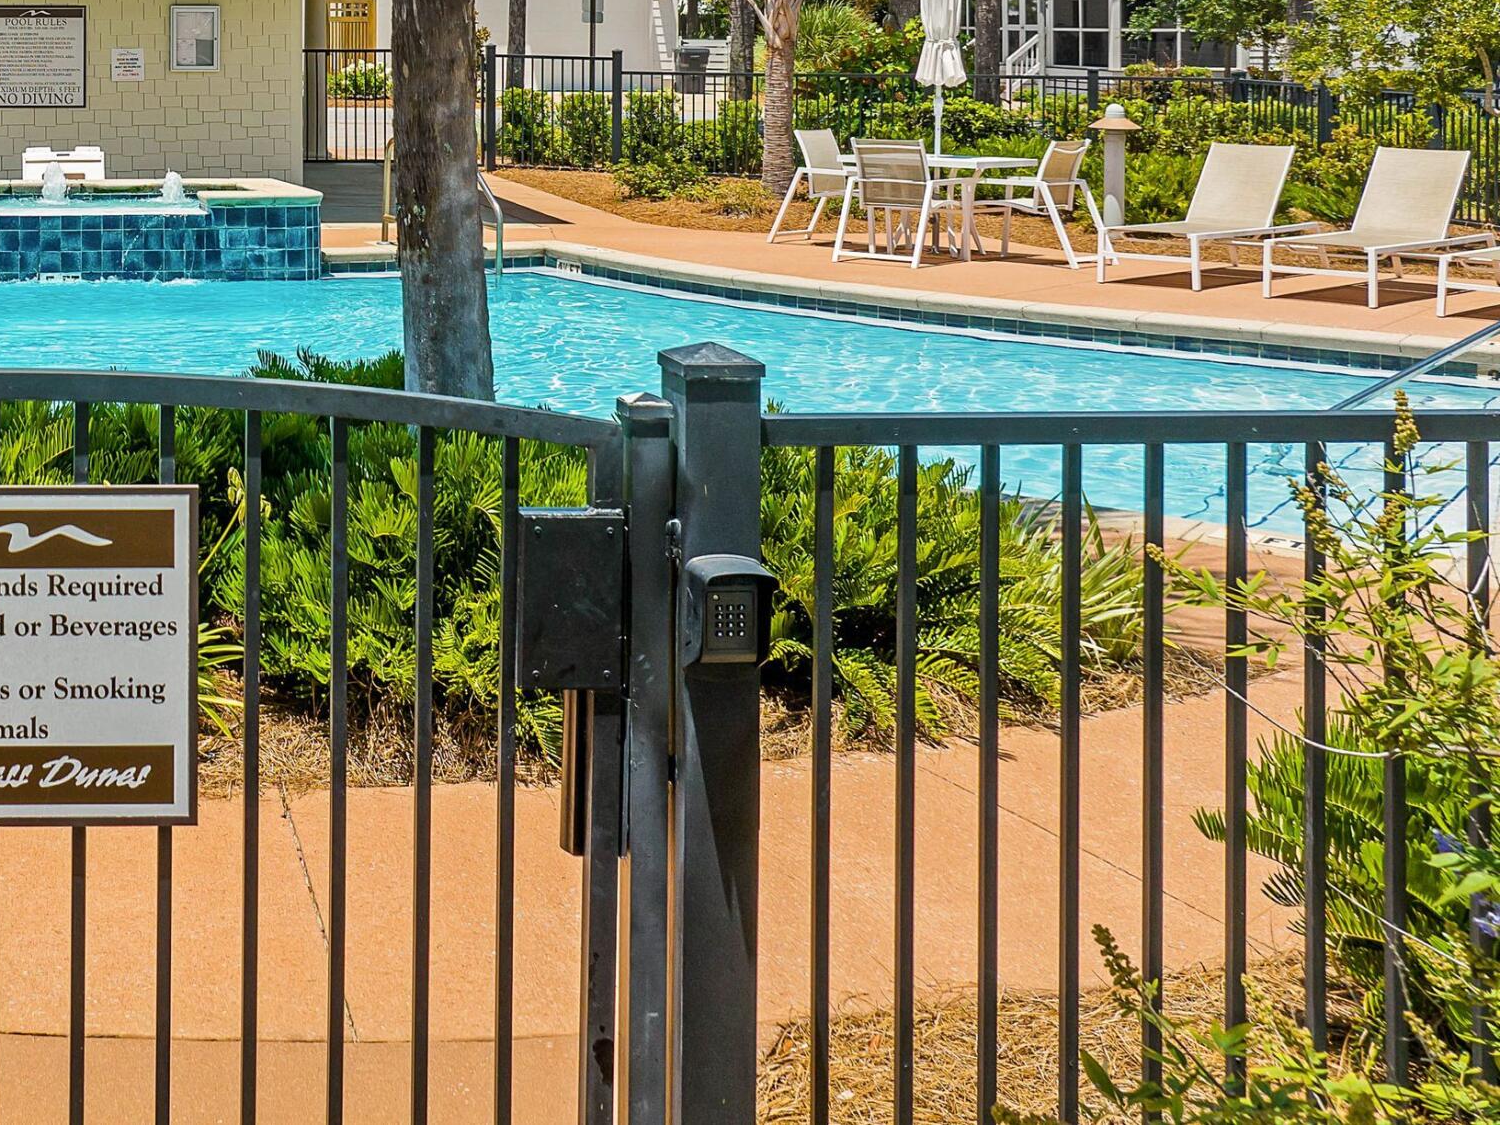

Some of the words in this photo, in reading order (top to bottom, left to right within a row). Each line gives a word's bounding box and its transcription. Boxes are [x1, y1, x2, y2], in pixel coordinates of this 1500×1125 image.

[5, 18, 33, 26] POOL
[35, 18, 68, 26] RULES
[22, 93, 74, 104] DIVING
[47, 573, 164, 602] Required
[14, 622, 41, 637] or
[50, 614, 178, 641] Beverages
[18, 685, 46, 700] or
[53, 677, 166, 704] Smoking
[39, 756, 151, 789] Dunes
